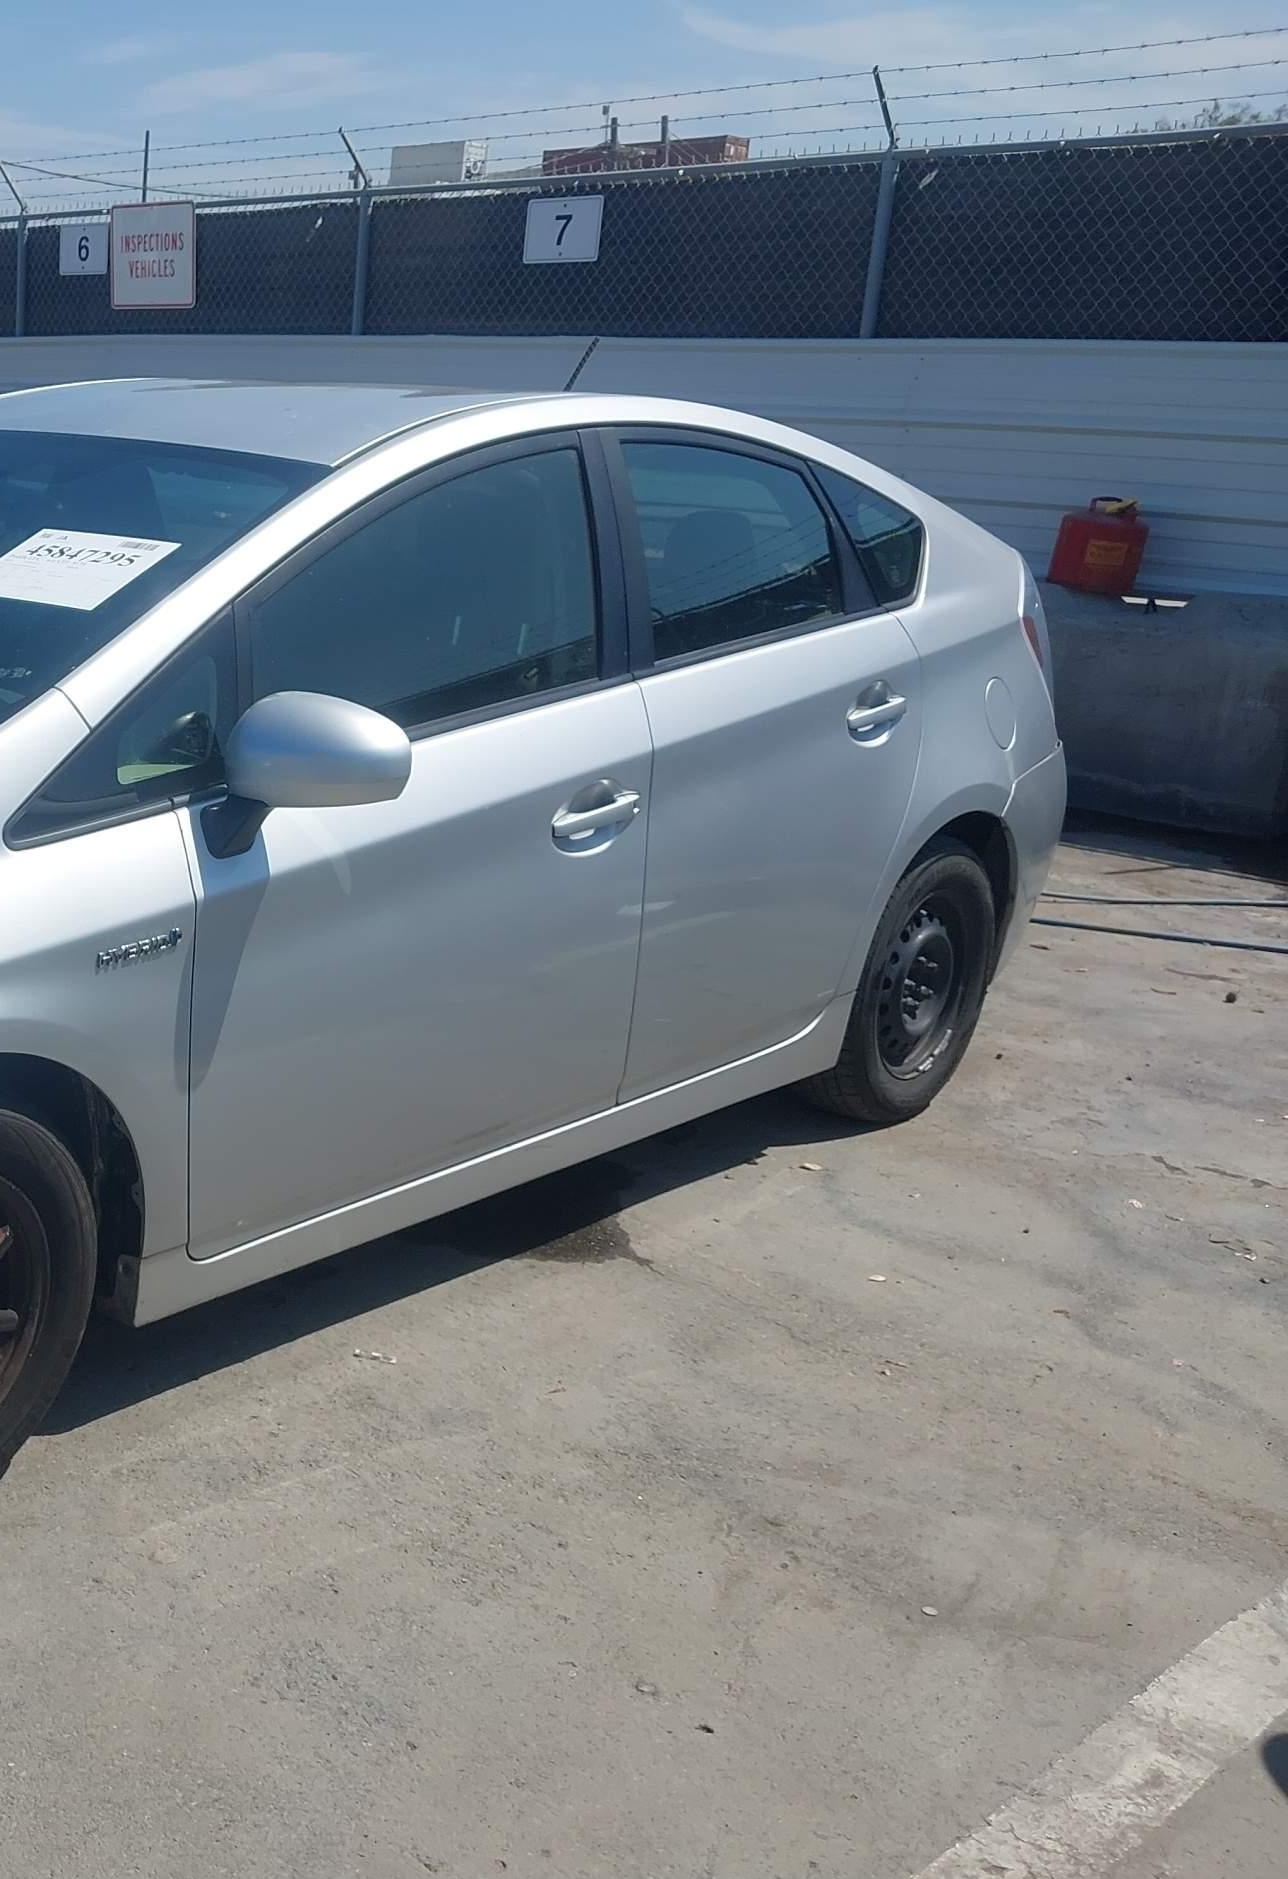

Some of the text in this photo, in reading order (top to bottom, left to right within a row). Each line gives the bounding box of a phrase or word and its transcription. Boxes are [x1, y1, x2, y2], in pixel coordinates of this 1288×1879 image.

[555, 214, 573, 246] 7
[78, 235, 90, 262] 6
[120, 232, 185, 254] INSPECTIONS
[128, 258, 176, 279] VEHICLES
[26, 544, 142, 567] 45847295
[96, 934, 170, 969] HYBRID
